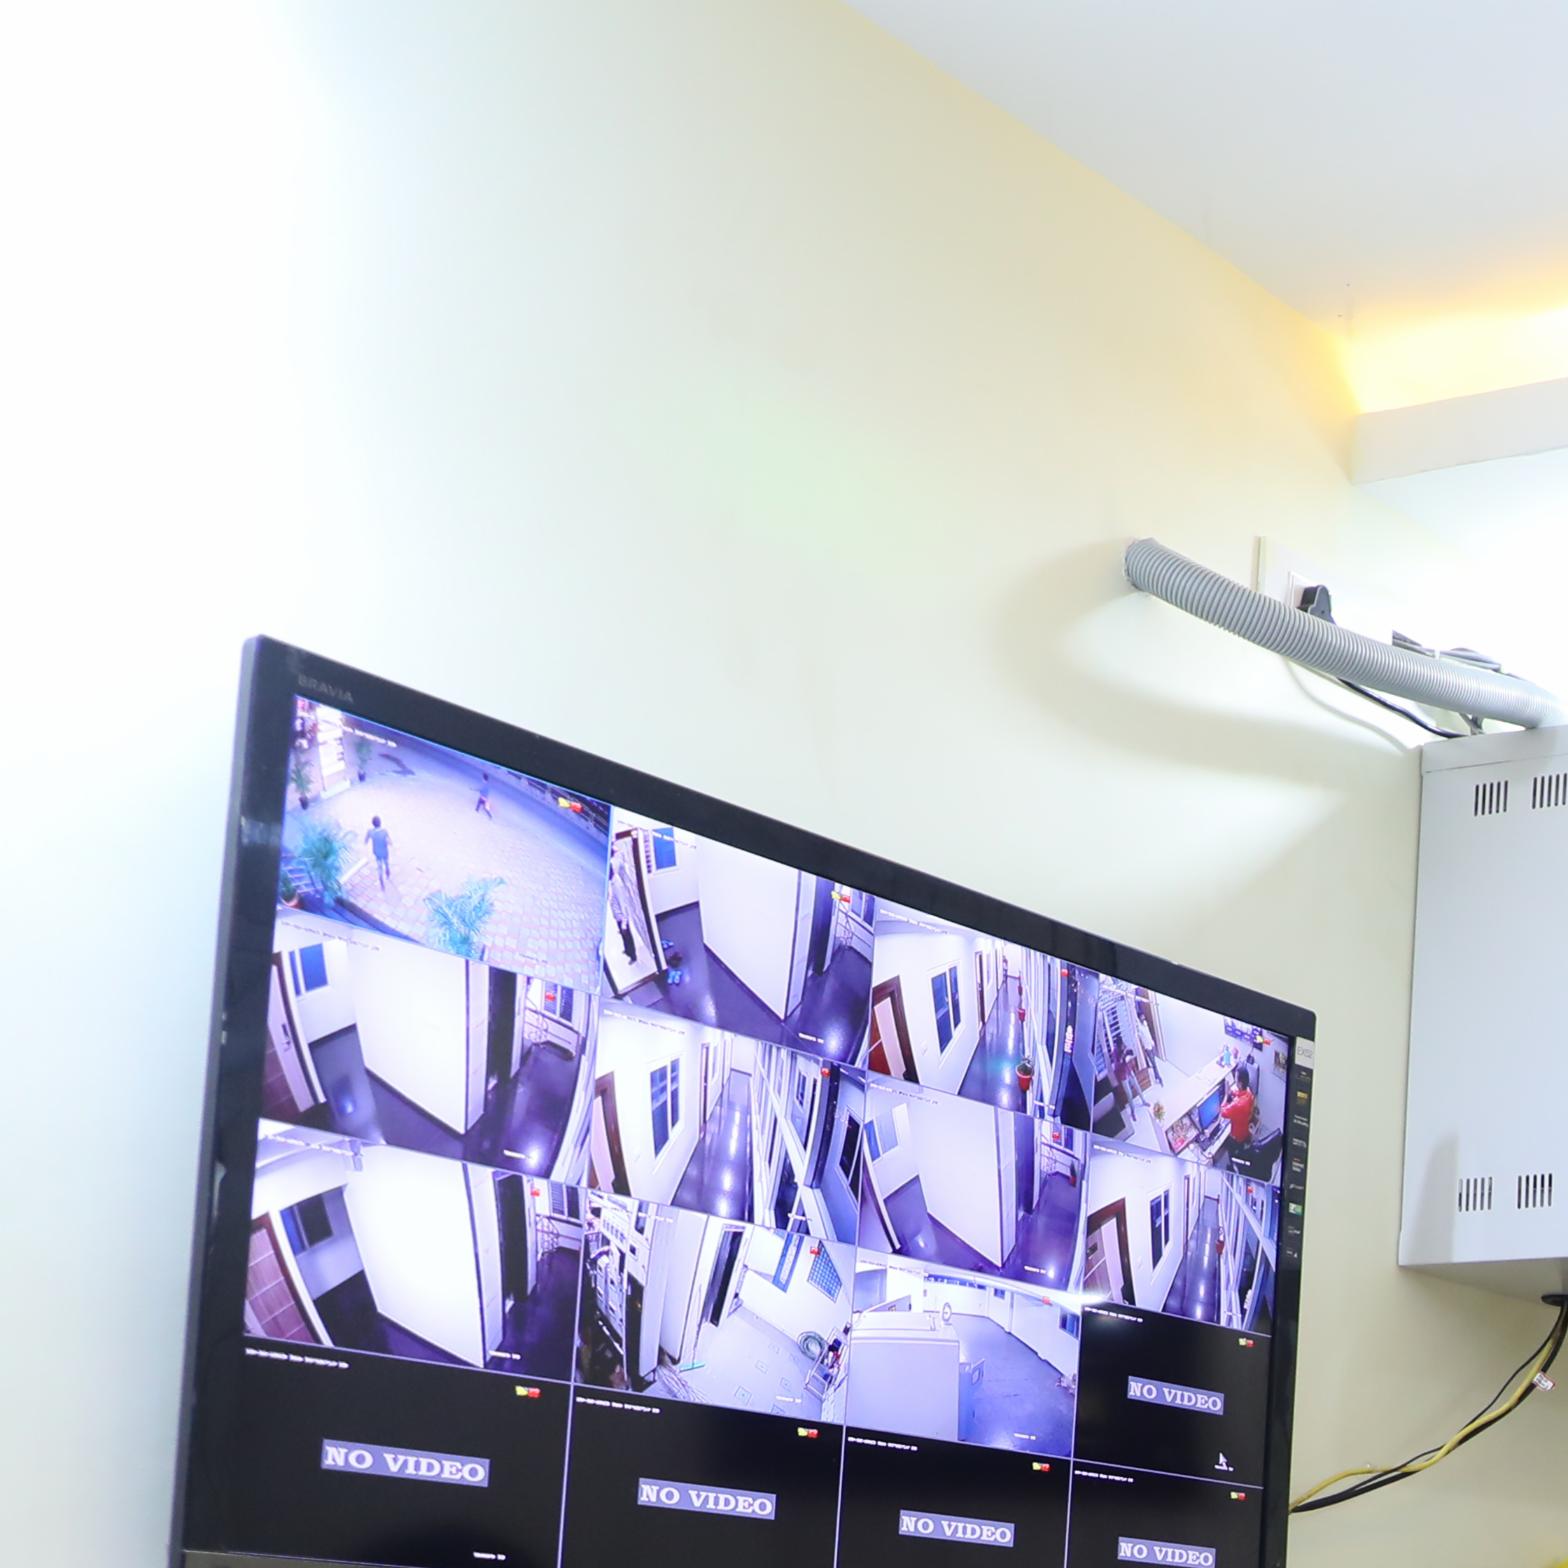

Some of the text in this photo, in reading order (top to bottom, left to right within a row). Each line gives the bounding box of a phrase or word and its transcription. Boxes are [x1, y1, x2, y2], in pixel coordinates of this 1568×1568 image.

[1129, 1381, 1222, 1411] NO VIDEO
[324, 1446, 486, 1482] NO VIDEO
[640, 1484, 773, 1515] NO VIDEO
[901, 1515, 1012, 1543] NO VIDEO
[1119, 1542, 1213, 1566] NO VIDEO
